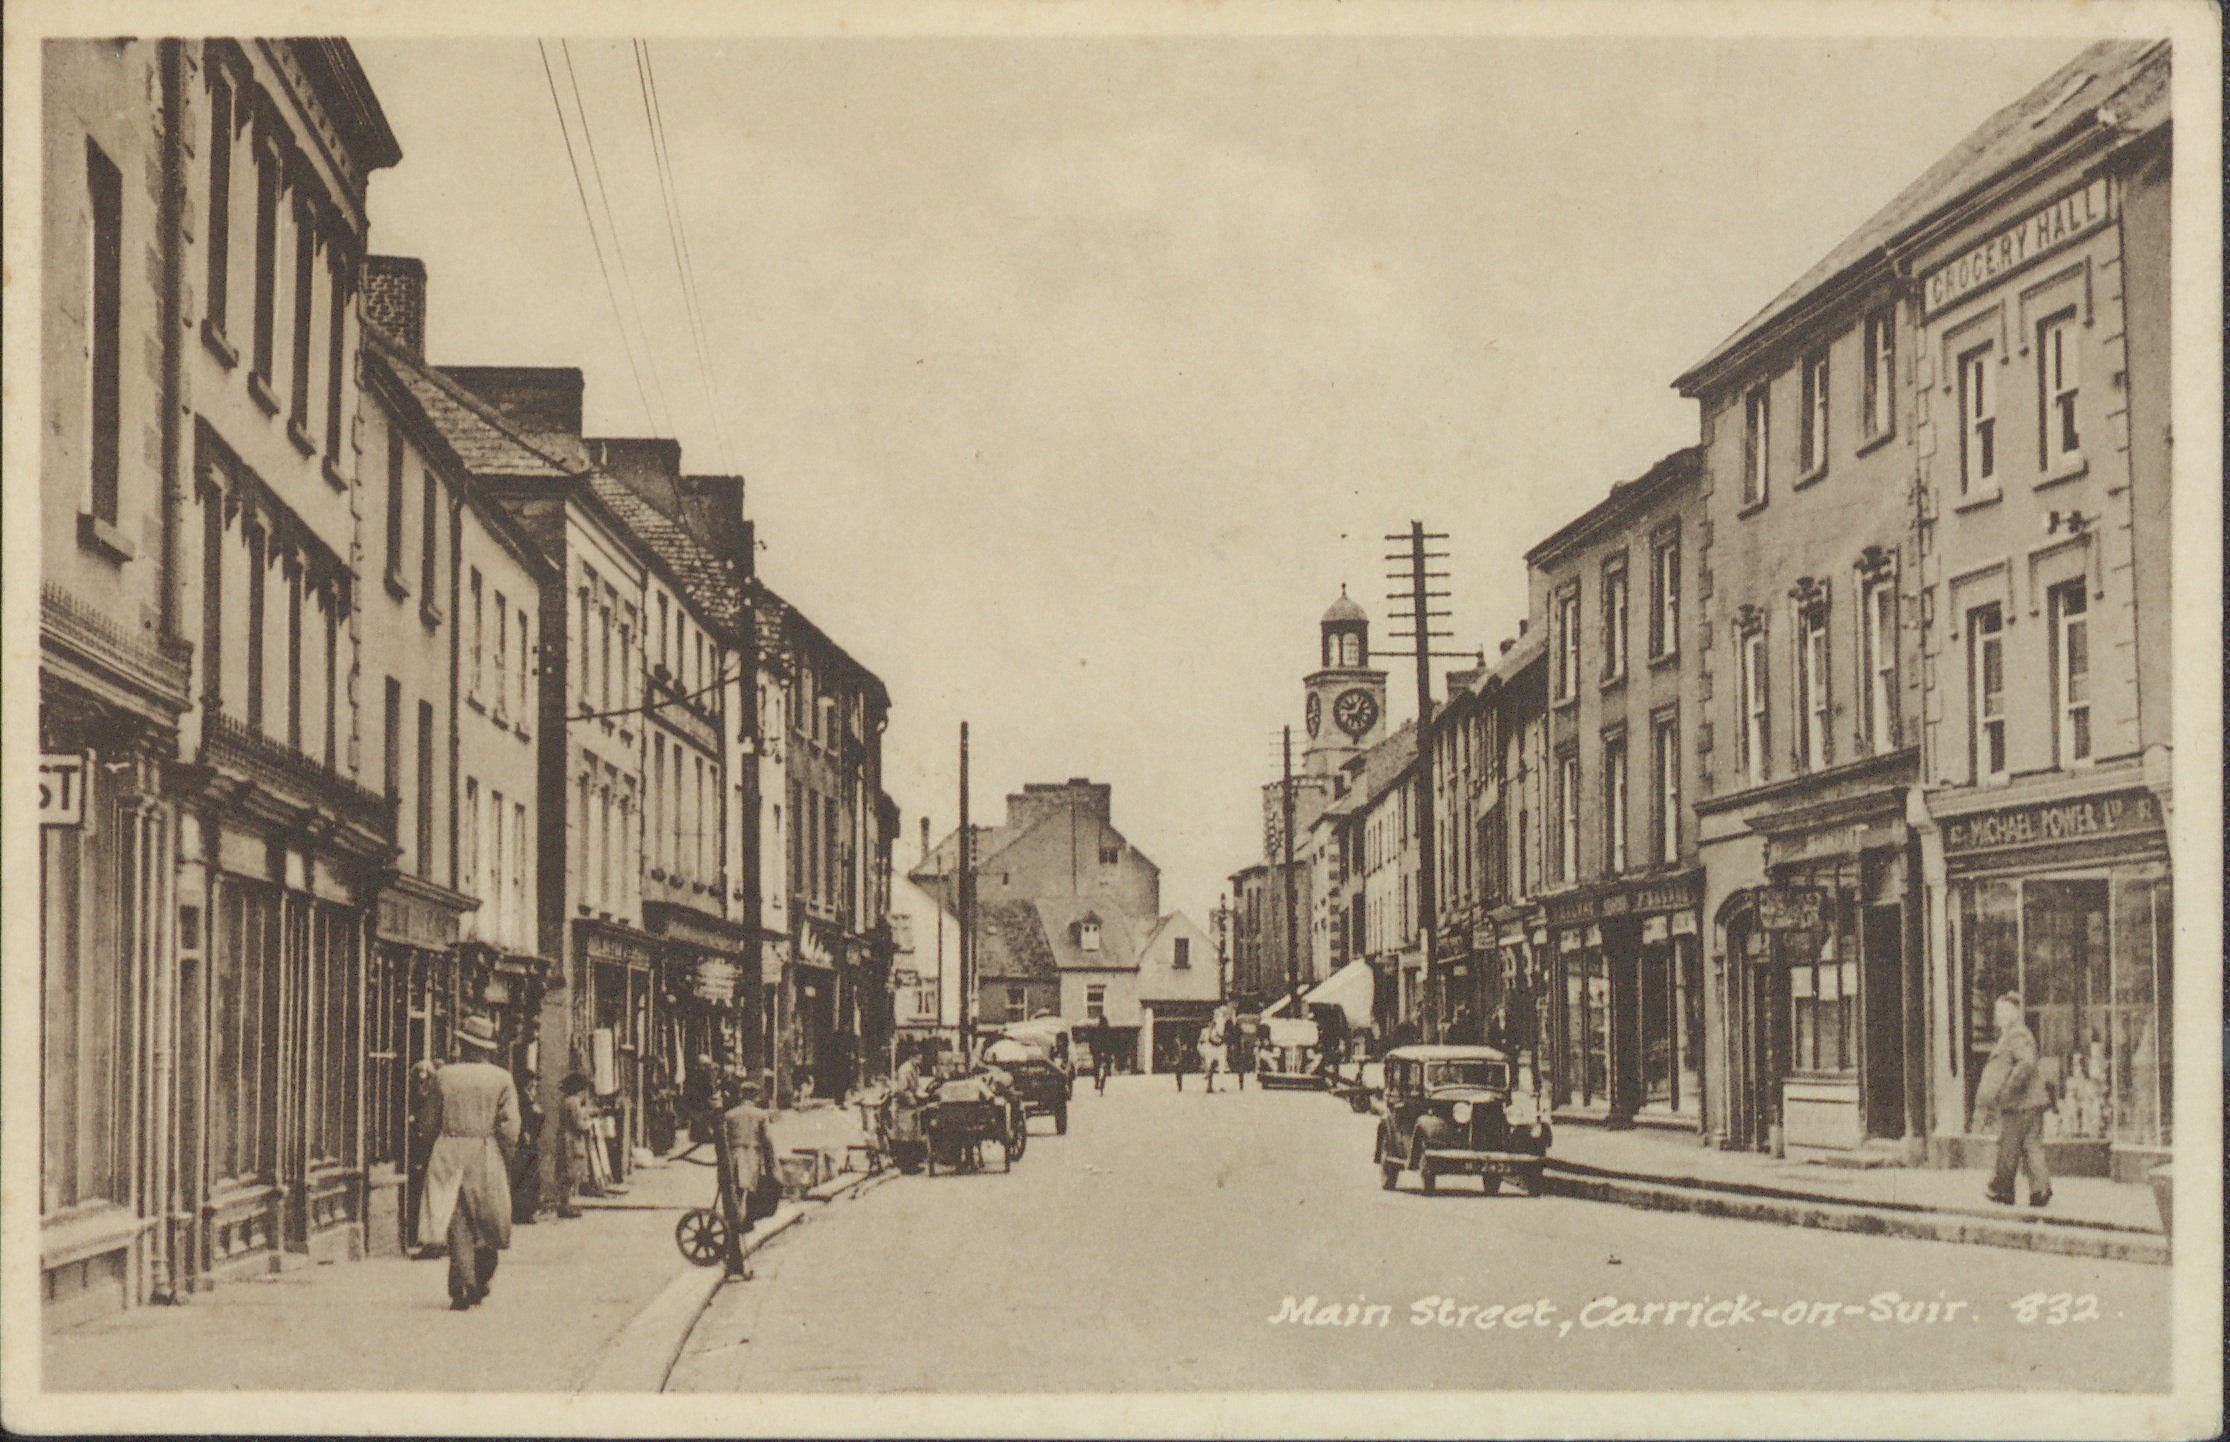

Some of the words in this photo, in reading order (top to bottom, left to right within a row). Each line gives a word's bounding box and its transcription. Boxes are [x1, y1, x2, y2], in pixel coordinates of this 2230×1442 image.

[1932, 221, 2028, 304] GROCERY
[2037, 188, 2096, 249] HALL
[1970, 813, 2033, 845] MICHAEL
[2040, 802, 2097, 838] POWER
